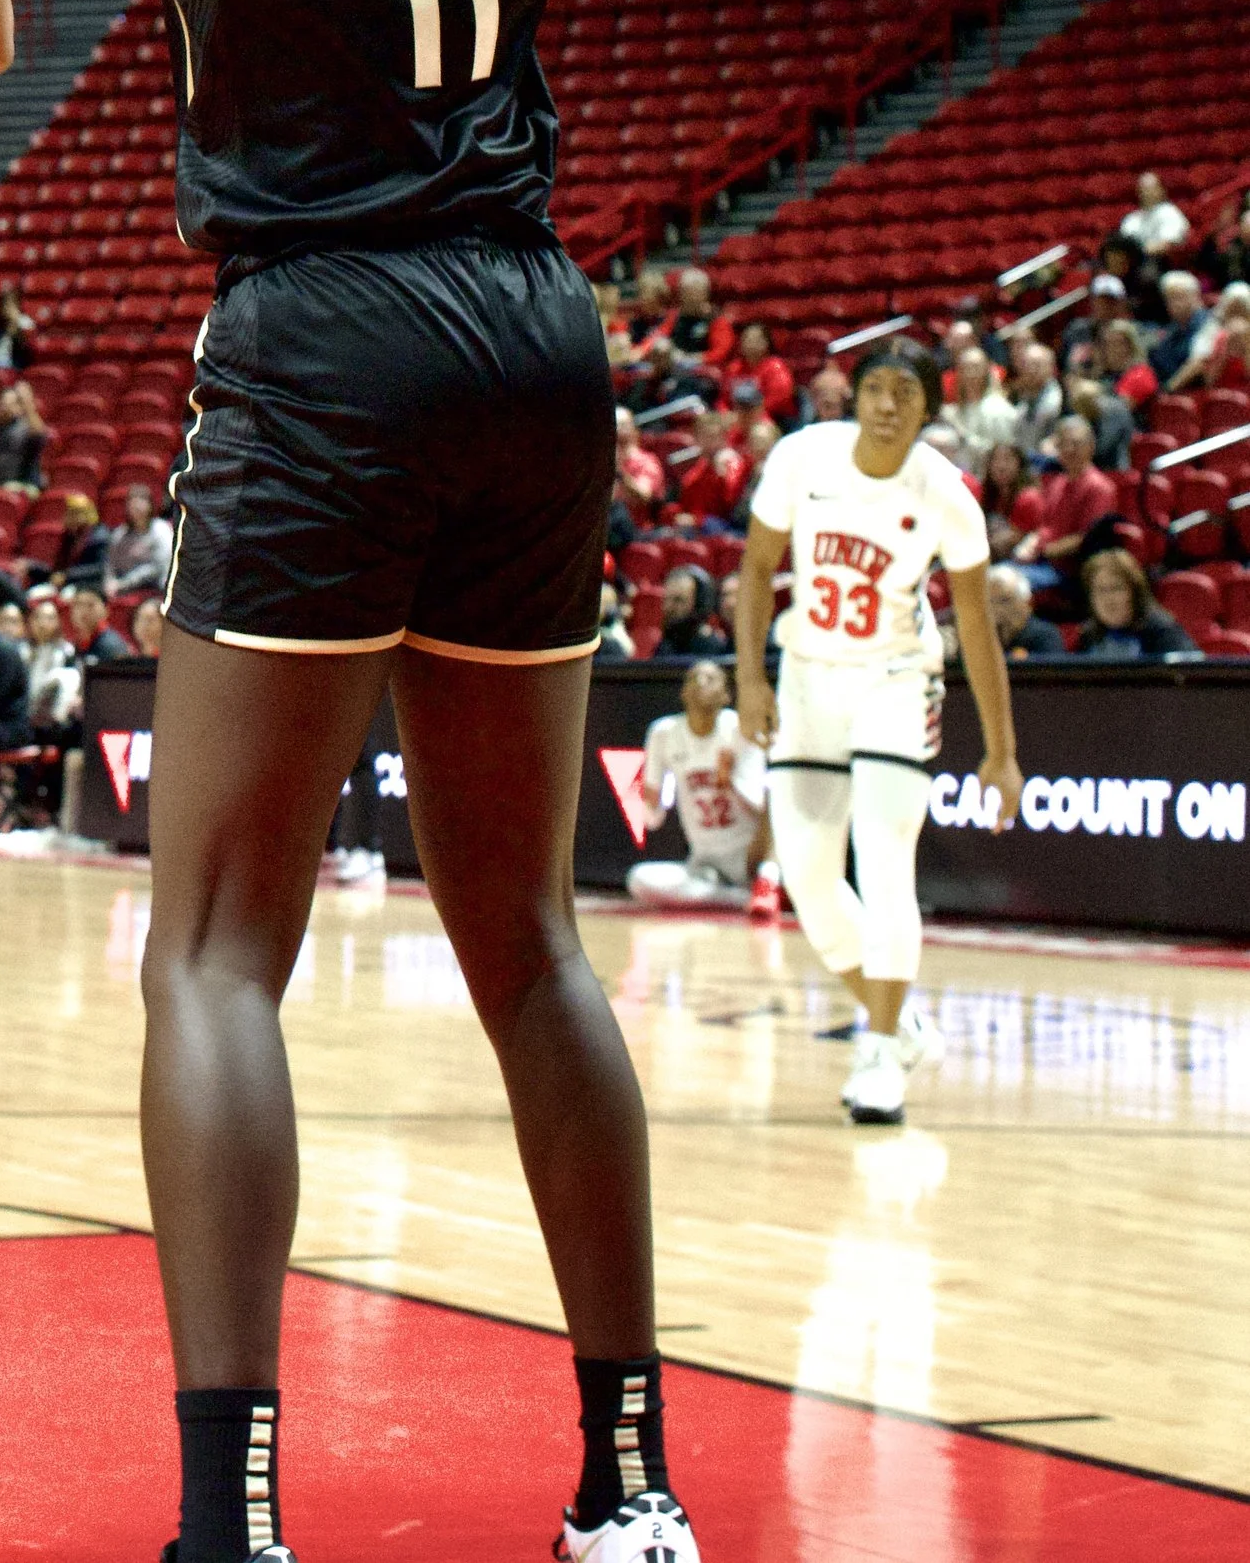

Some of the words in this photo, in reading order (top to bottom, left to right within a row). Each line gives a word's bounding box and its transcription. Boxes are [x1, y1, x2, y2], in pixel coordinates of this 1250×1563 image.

[813, 530, 895, 584] UNLV
[808, 575, 881, 640] 33
[1020, 775, 1172, 837] COUNT
[1176, 781, 1247, 842] ON
